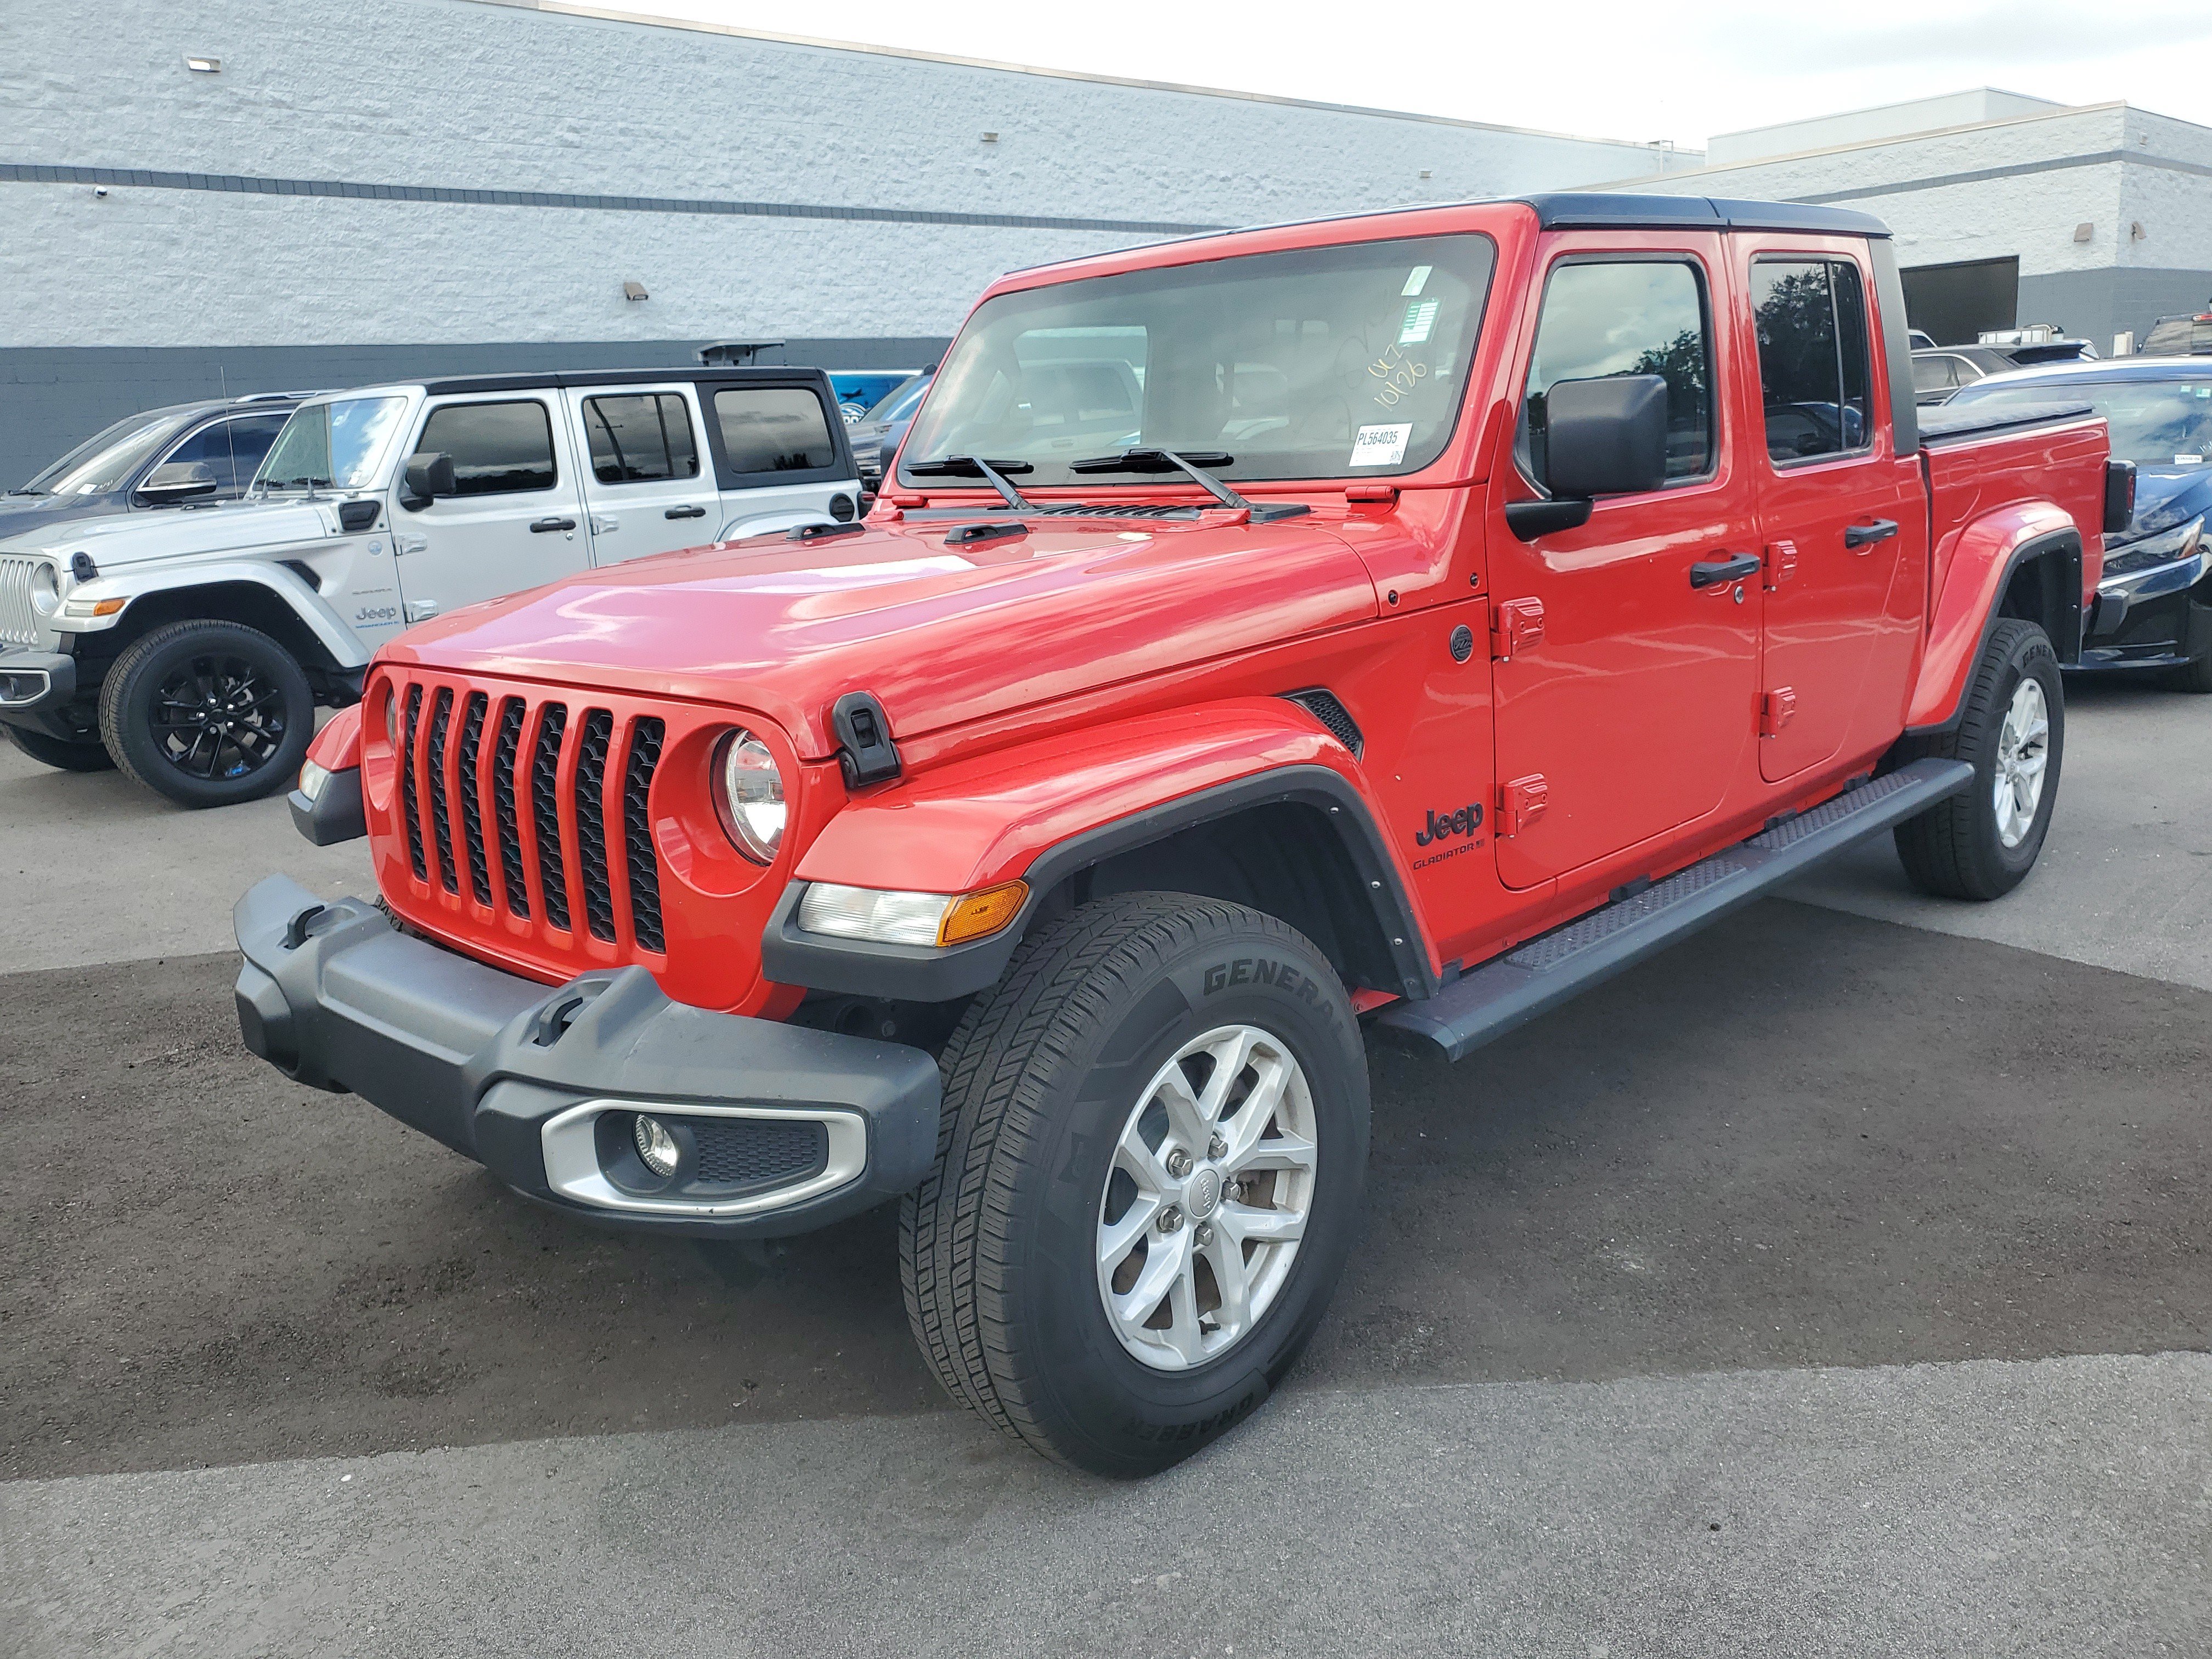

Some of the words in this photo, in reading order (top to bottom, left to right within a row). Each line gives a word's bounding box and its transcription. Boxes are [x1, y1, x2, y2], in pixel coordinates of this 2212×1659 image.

[1357, 431, 1398, 445] PL564035
[356, 606, 397, 620] Jeep
[1415, 801, 1483, 847] Jeep
[1413, 843, 1475, 871] GLADIATOR
[1200, 1177, 1211, 1209] Jeep
